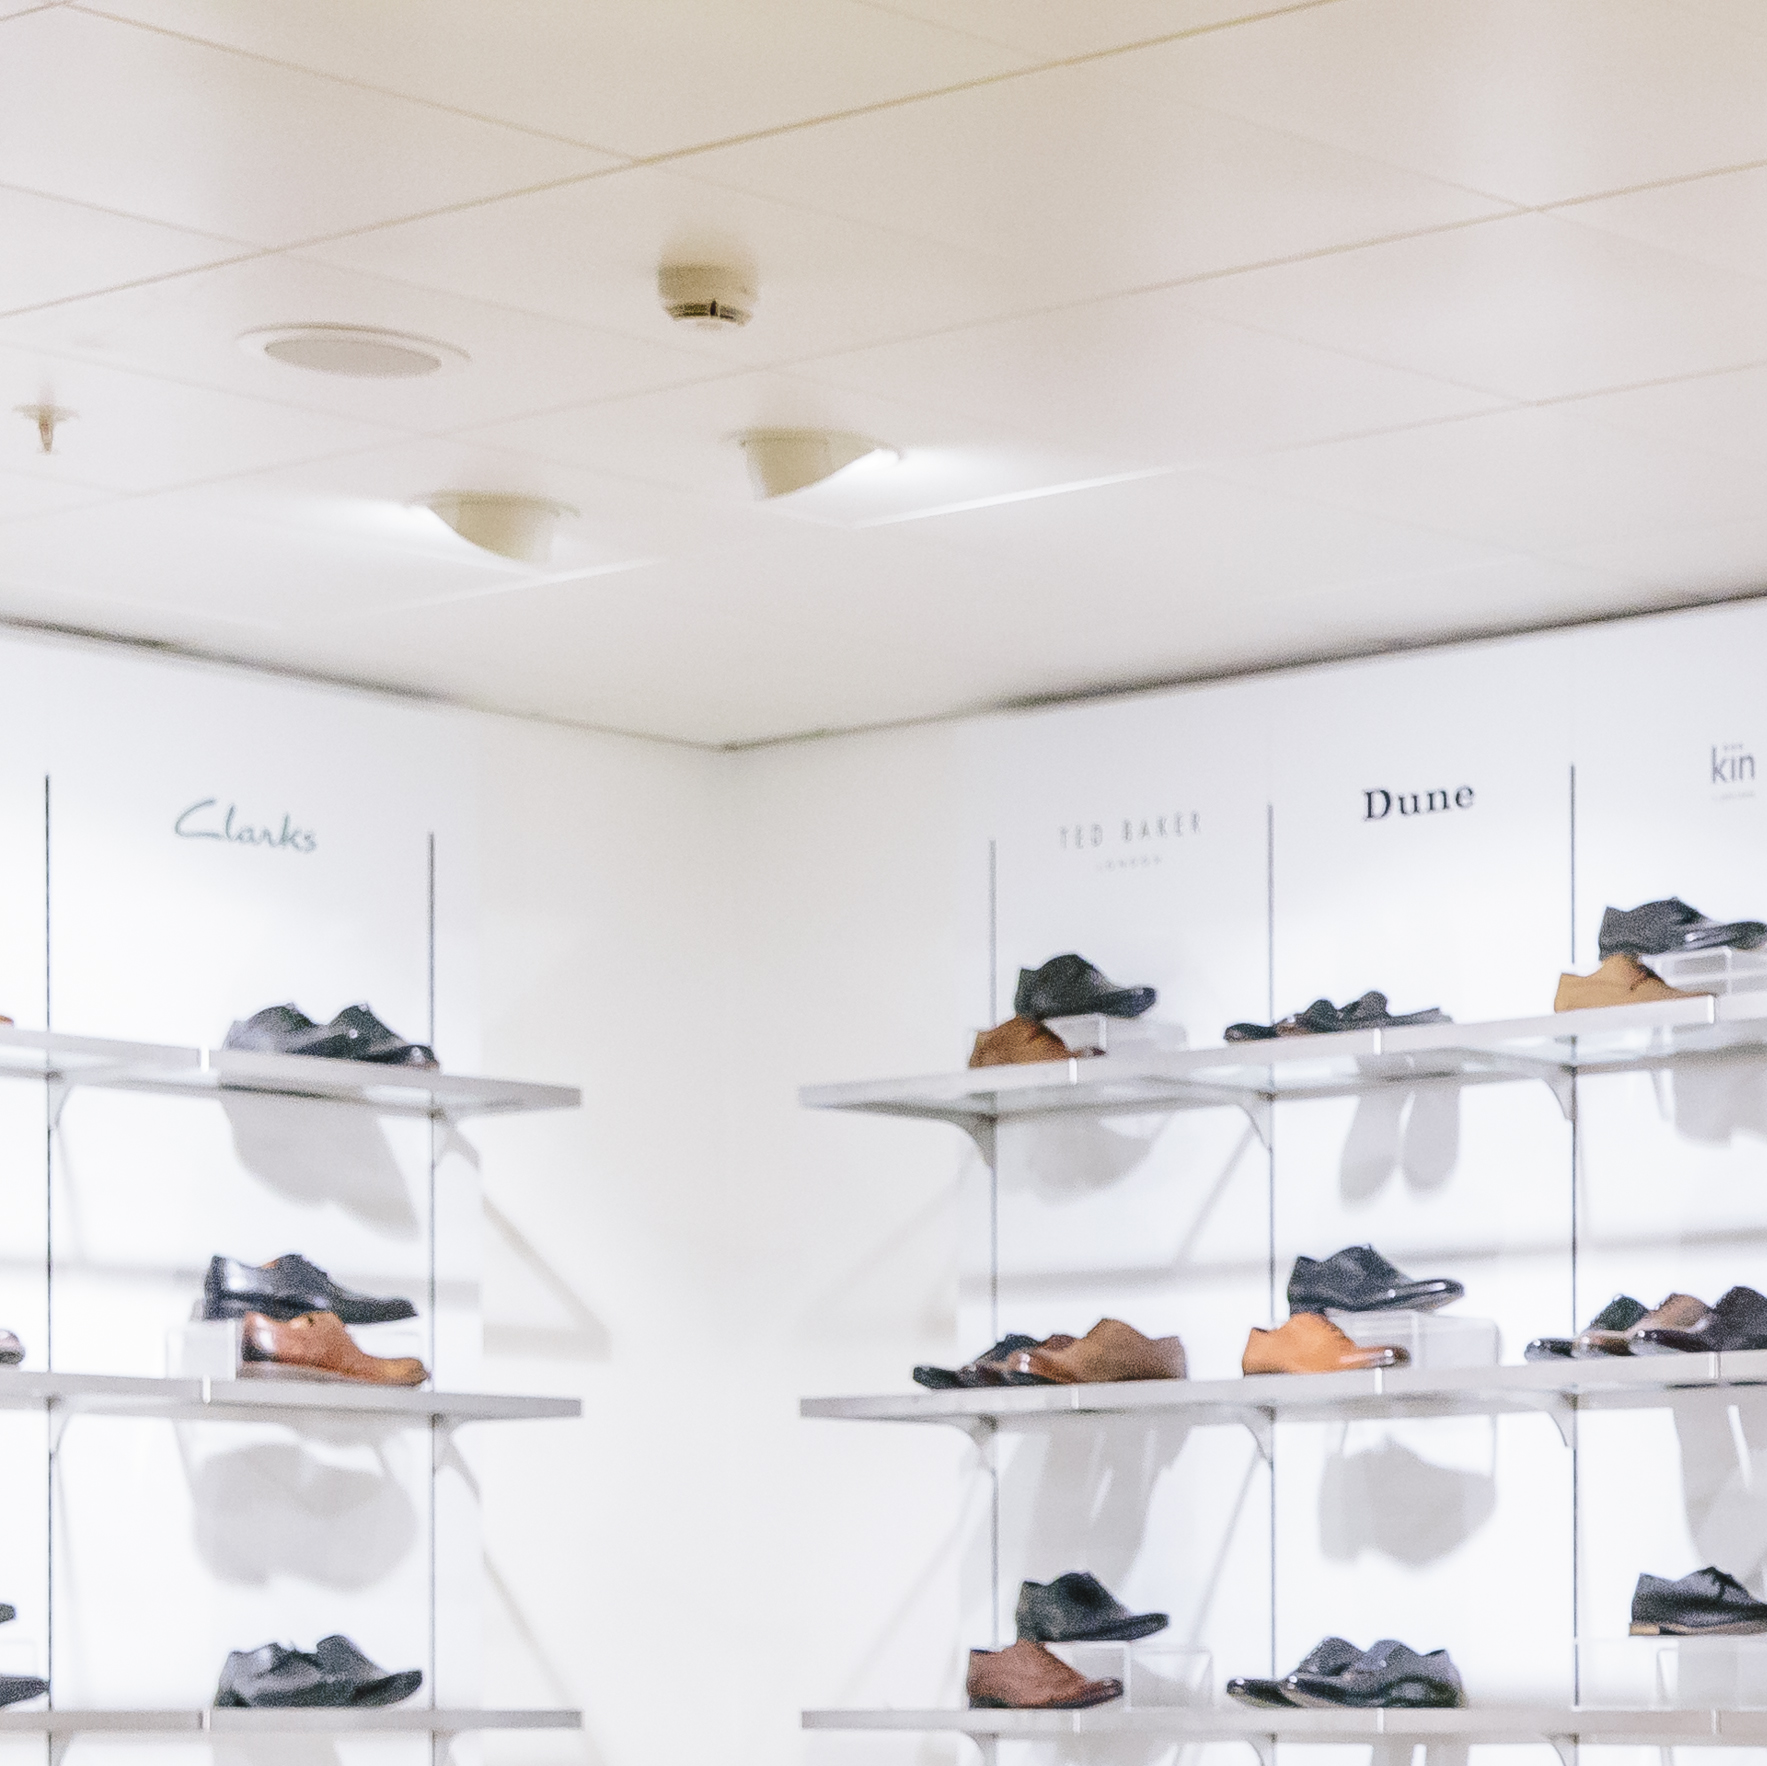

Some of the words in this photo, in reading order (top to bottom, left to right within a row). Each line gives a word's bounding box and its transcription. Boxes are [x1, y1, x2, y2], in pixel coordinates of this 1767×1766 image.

[1710, 743, 1756, 784] kin
[1361, 785, 1475, 821] Dune
[174, 797, 318, 853] Clarks
[1059, 824, 1103, 850] TED
[1122, 810, 1202, 844] BAKER
